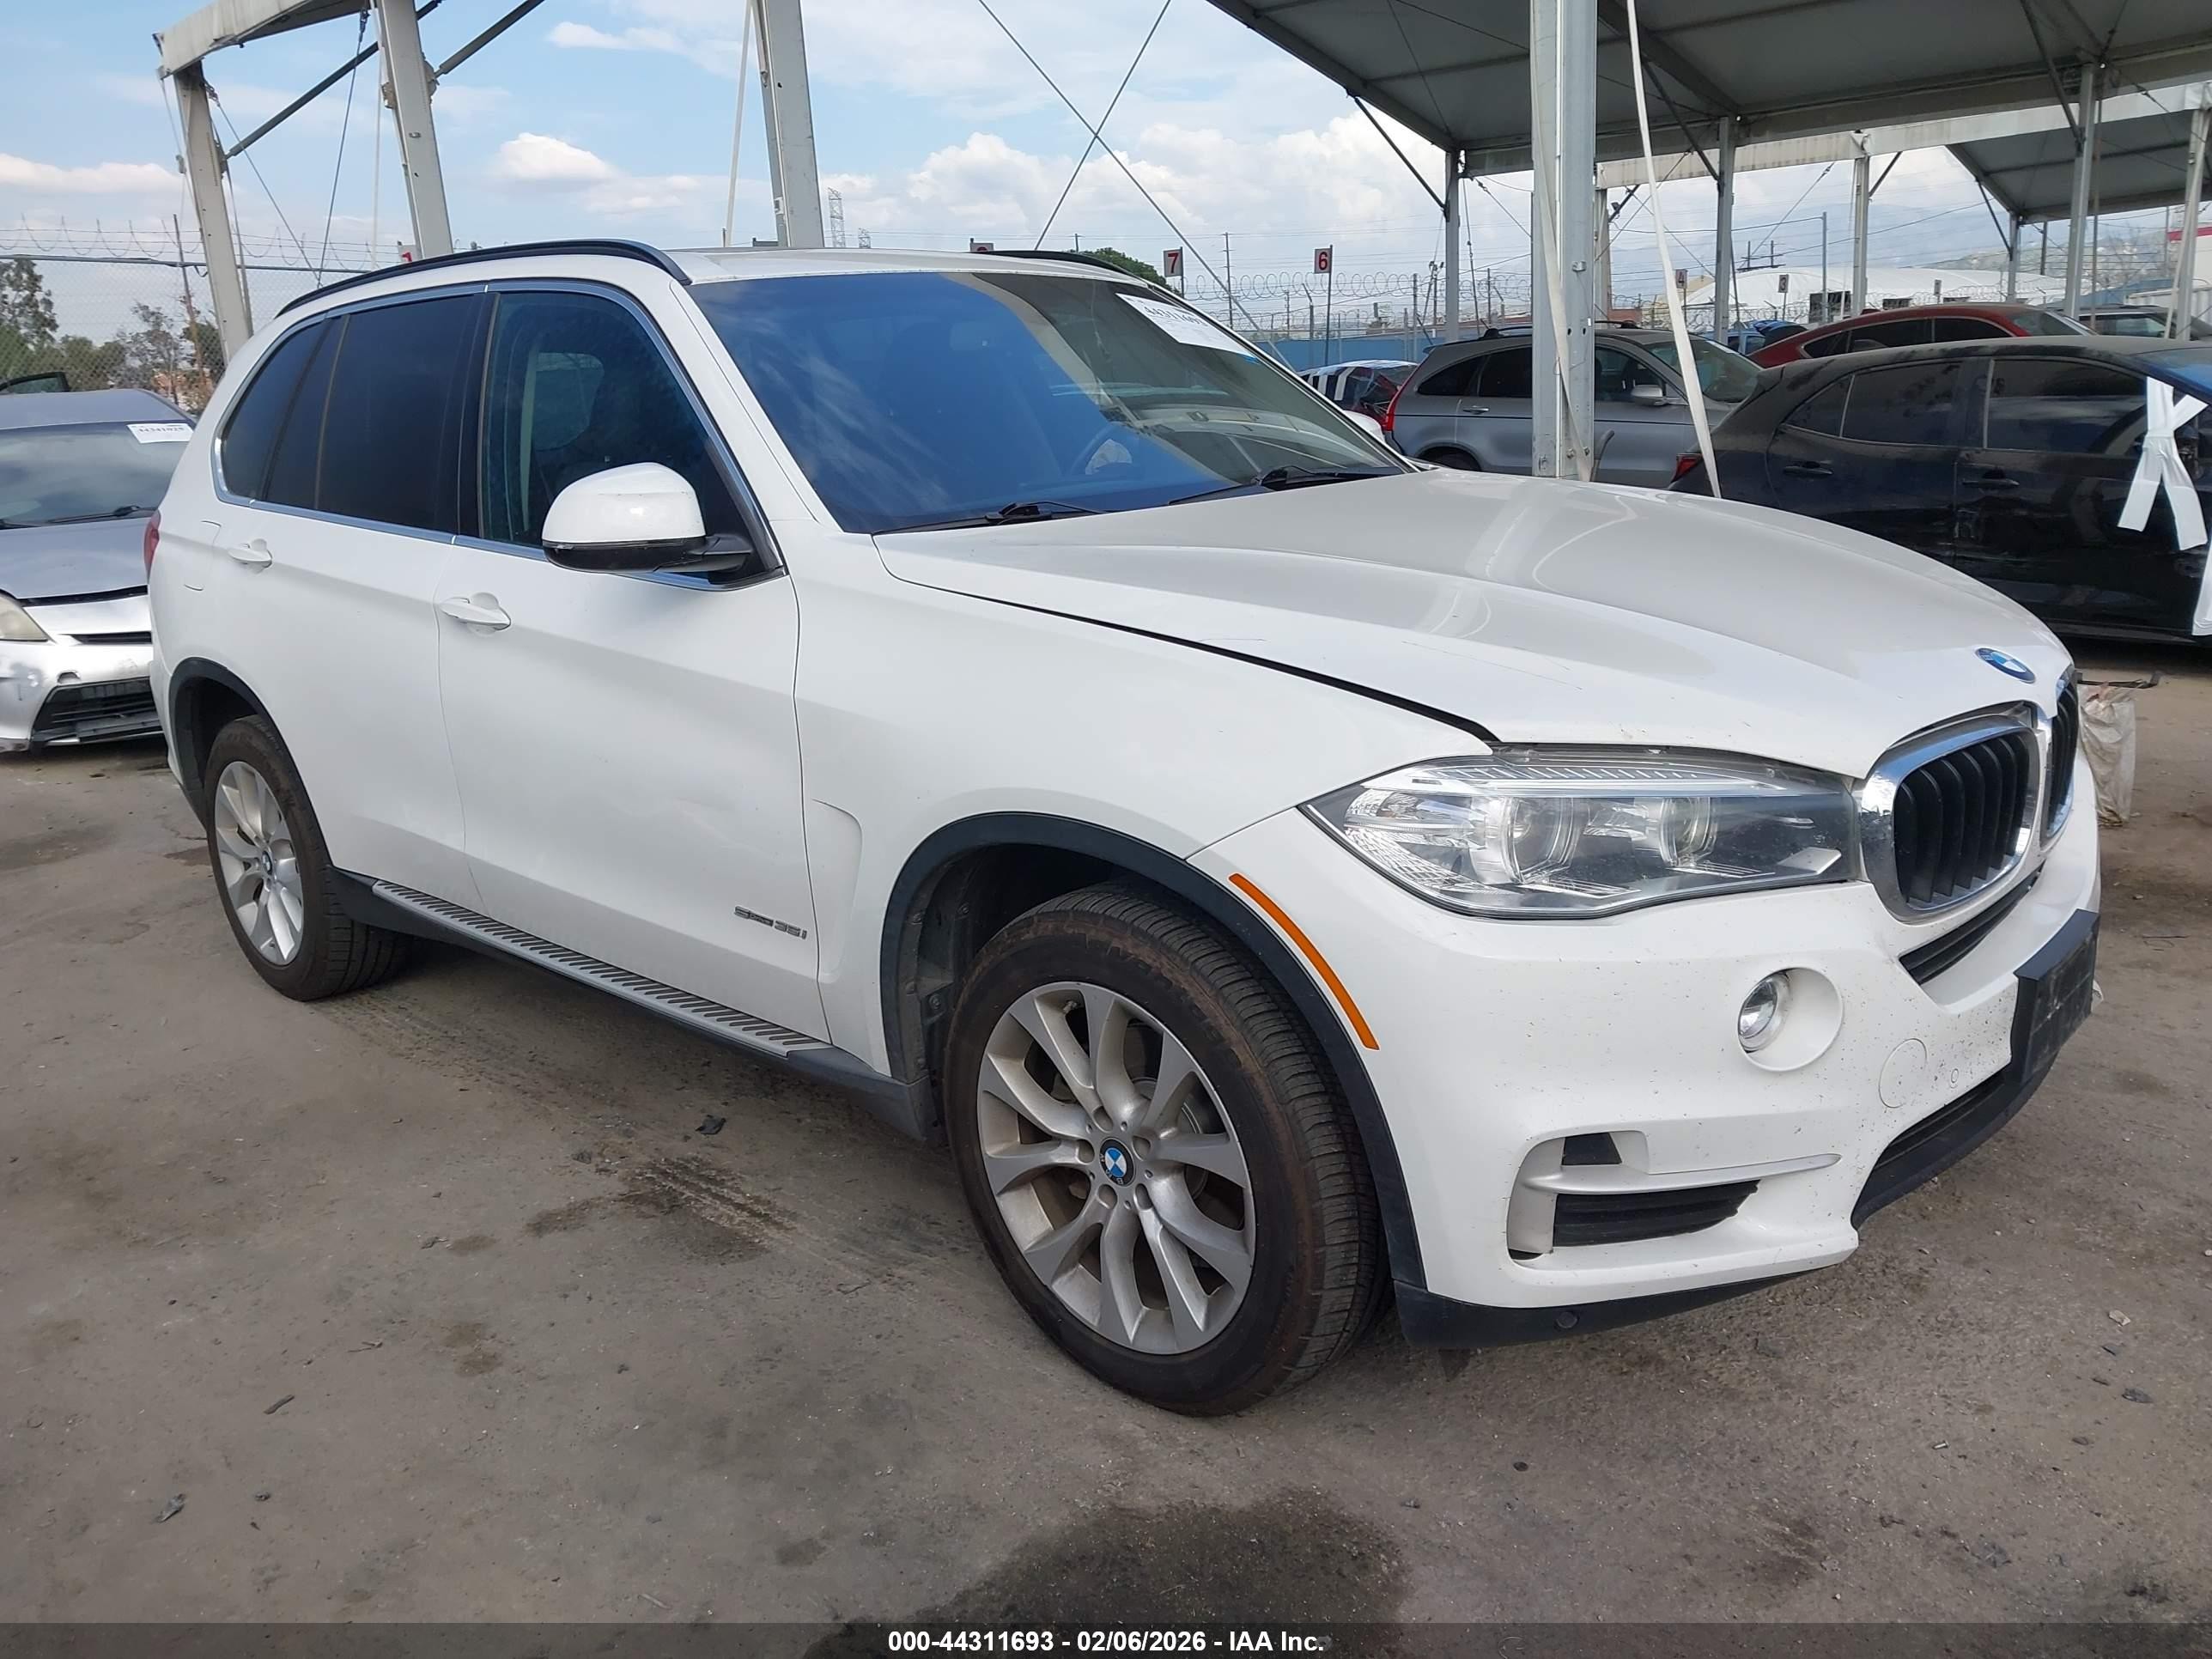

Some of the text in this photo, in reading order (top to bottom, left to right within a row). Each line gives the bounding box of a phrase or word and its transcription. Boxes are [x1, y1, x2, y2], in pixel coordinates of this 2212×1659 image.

[1167, 252, 1179, 274] 7
[1318, 252, 1328, 270] 6
[1678, 270, 1685, 287] 4
[1779, 276, 1787, 291] 3
